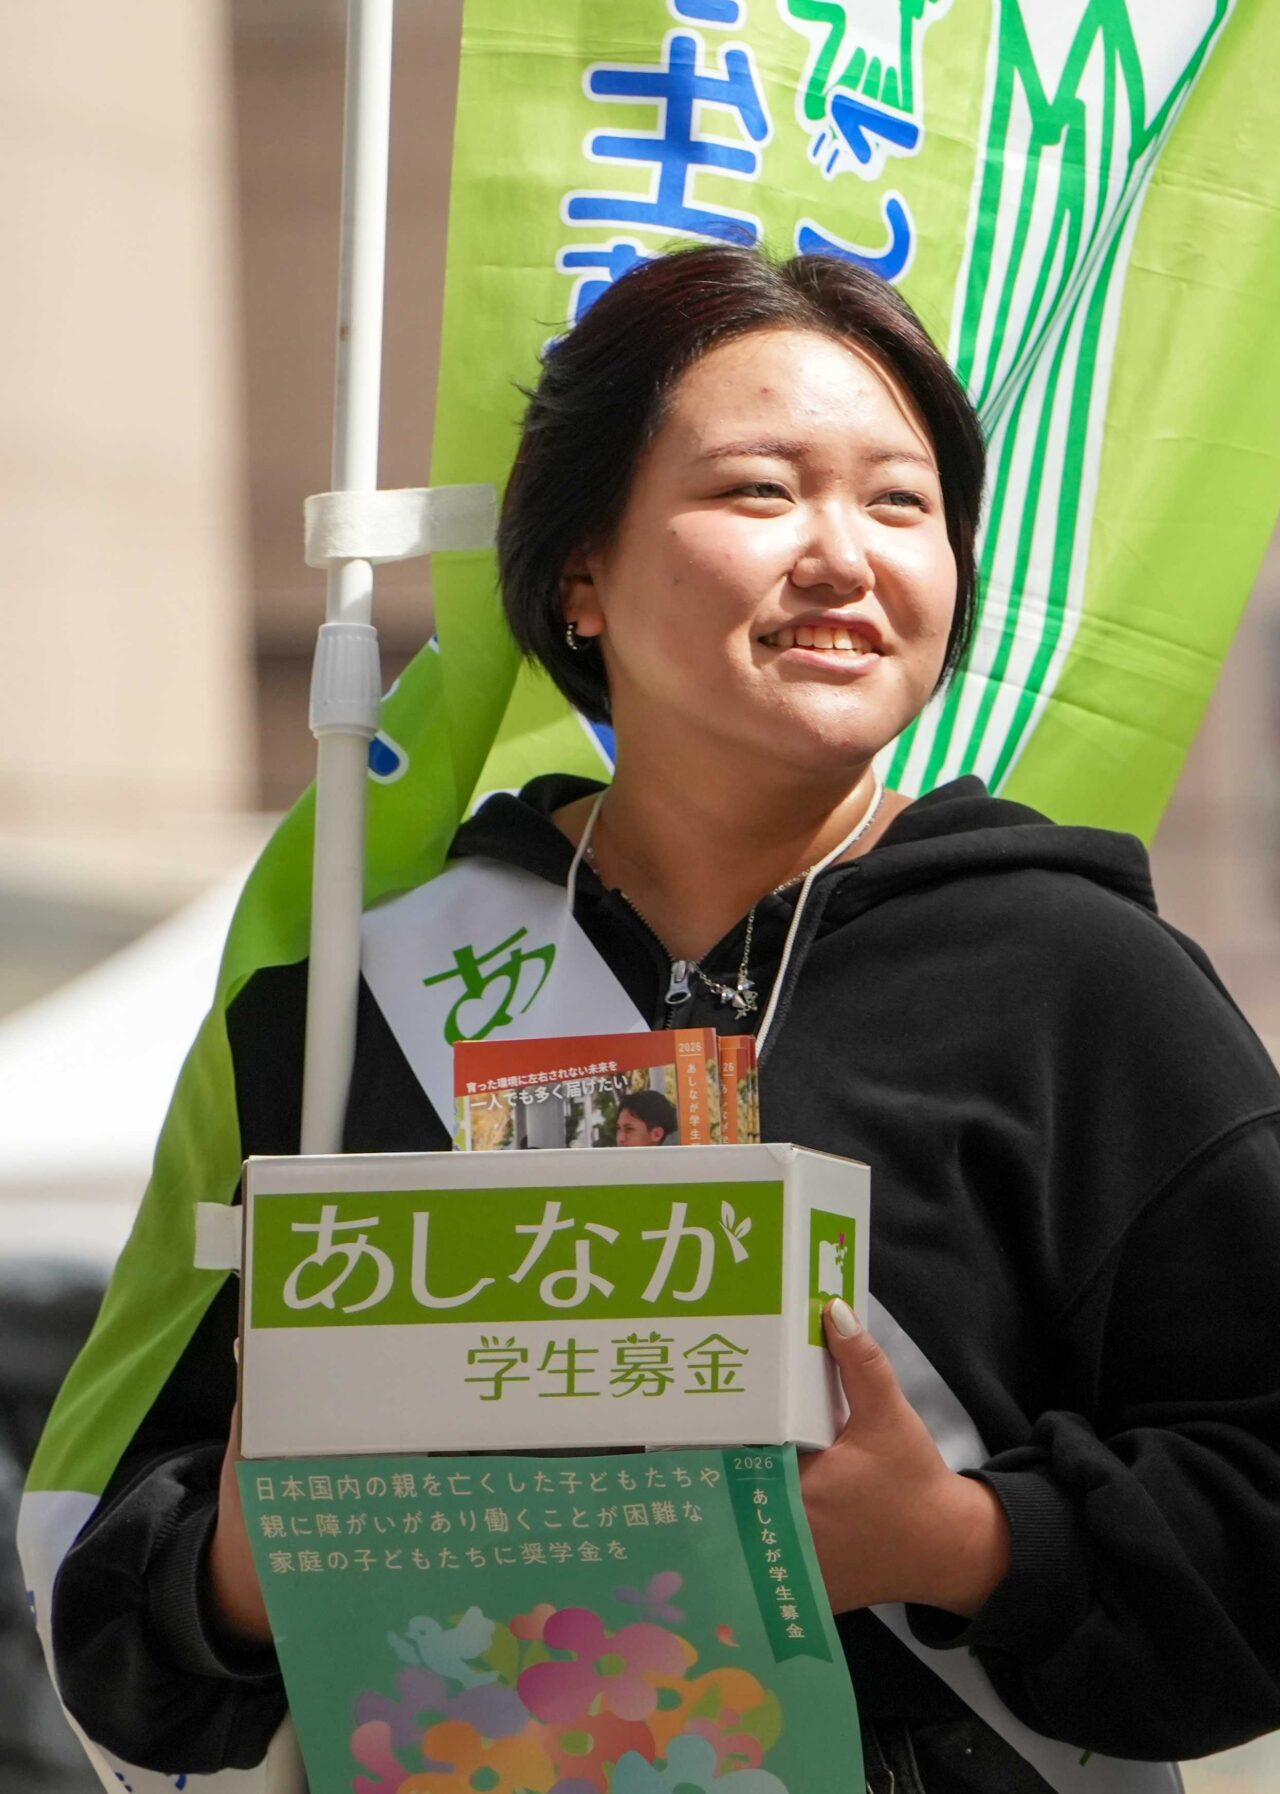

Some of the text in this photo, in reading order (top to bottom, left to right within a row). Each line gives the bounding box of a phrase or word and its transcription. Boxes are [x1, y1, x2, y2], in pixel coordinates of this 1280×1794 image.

[422, 926, 556, 1046] あ
[466, 1060, 618, 1094] 育った環境に左右されない未来を
[470, 1075, 629, 1111] 一人でも多く届けたい
[687, 1063, 702, 1146] あしなが学生
[282, 1199, 752, 1315] あしなが
[464, 1332, 750, 1402] 学生募金
[734, 1456, 774, 1470] 2026
[255, 1466, 721, 1502] 日本国内の親を亡くした子どもたちや
[260, 1500, 704, 1538] 親に障がいがあり働くことが困難な
[269, 1538, 629, 1574] 家庭の子どもたちに奨学金を
[753, 1488, 806, 1638] あしなが学生募金
